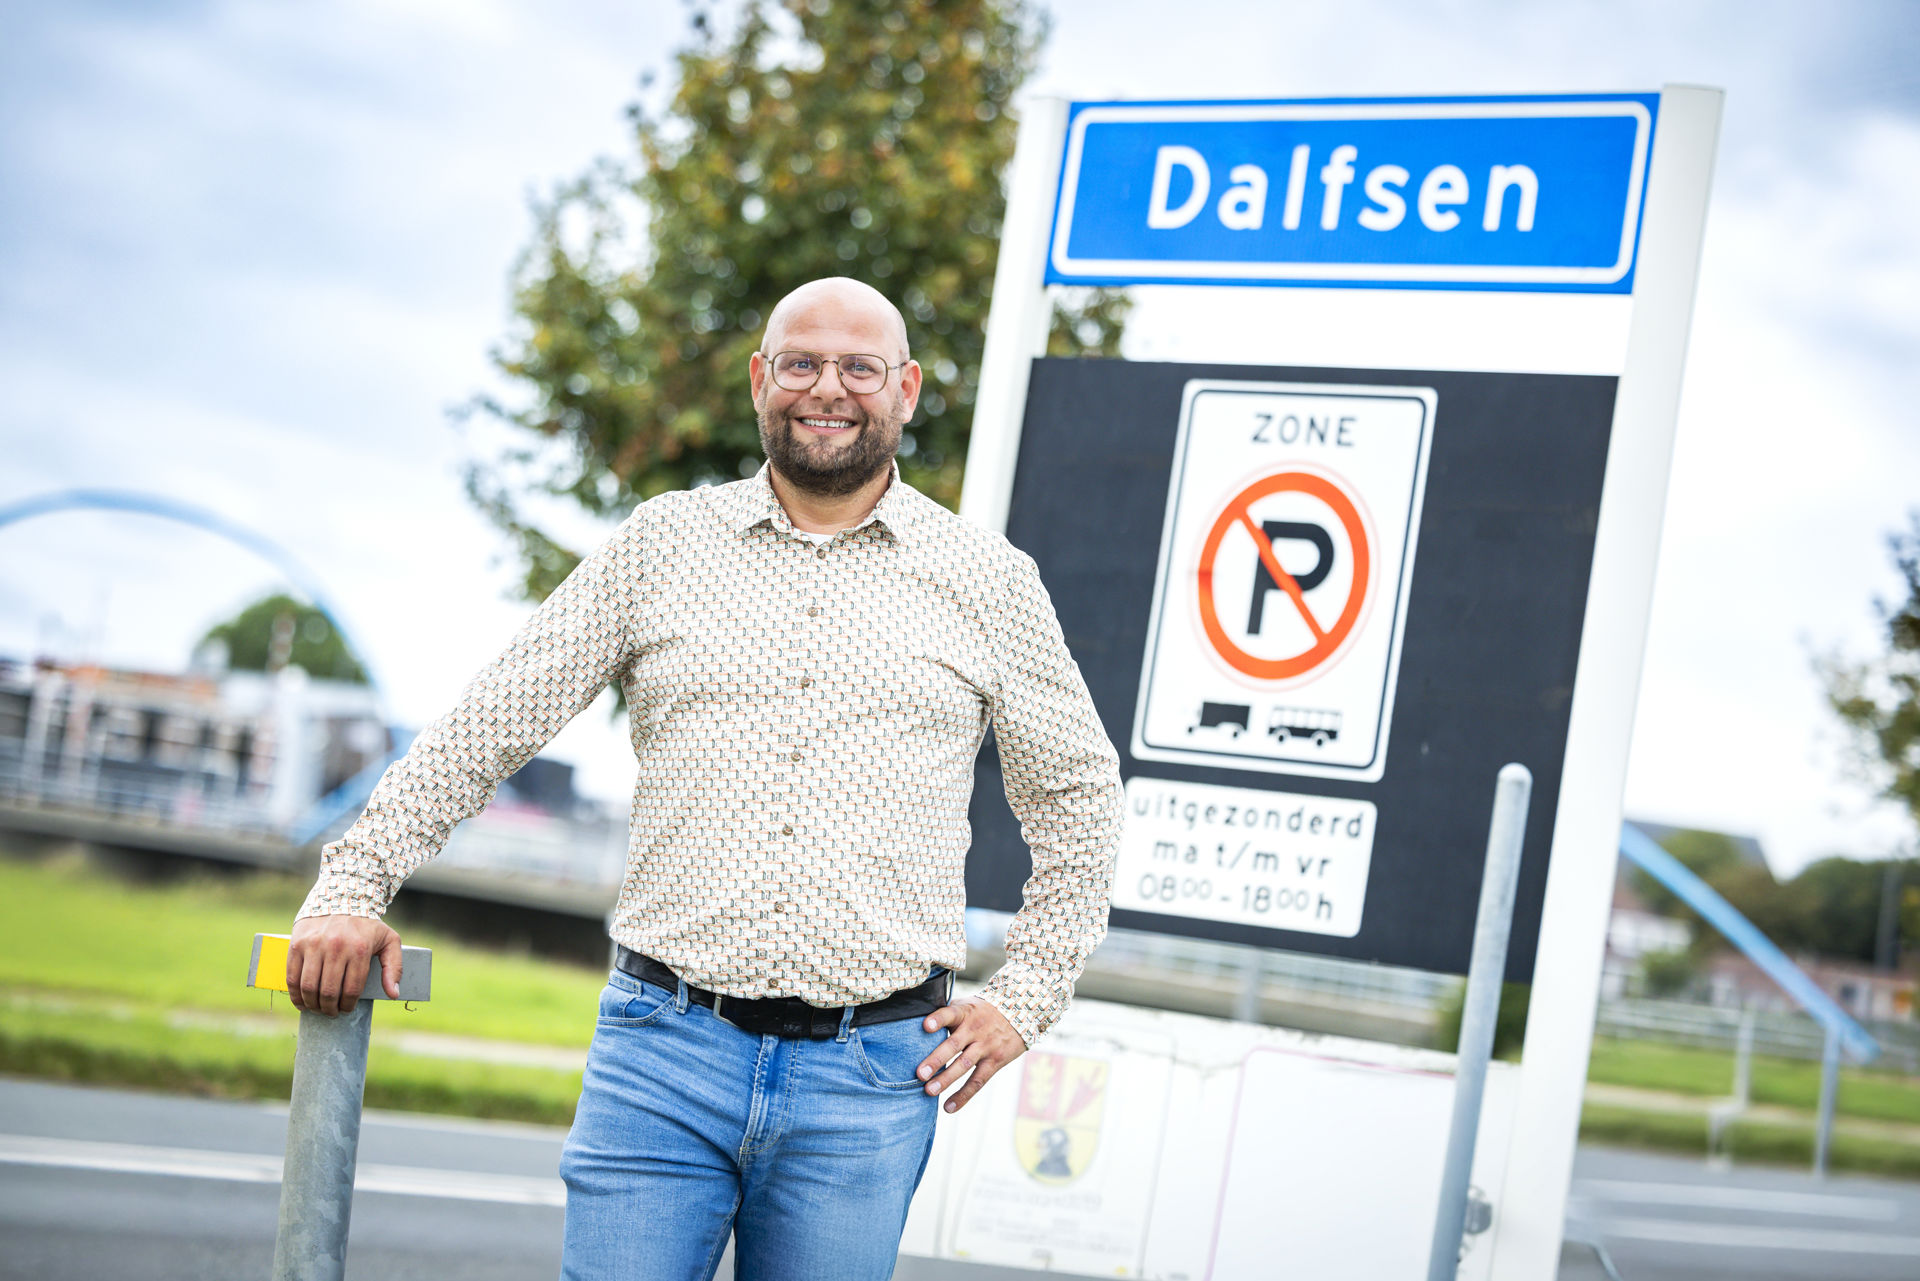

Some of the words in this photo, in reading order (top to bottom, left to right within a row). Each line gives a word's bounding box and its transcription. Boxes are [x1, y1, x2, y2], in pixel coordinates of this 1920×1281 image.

[1147, 145, 1539, 232] Dalfsen
[1251, 413, 1357, 447] ZONE
[1246, 520, 1334, 636] P
[1134, 795, 1364, 838] uitgezonderd
[1154, 841, 1198, 863] ma
[1217, 842, 1279, 872] t/m
[1297, 856, 1331, 877] vr
